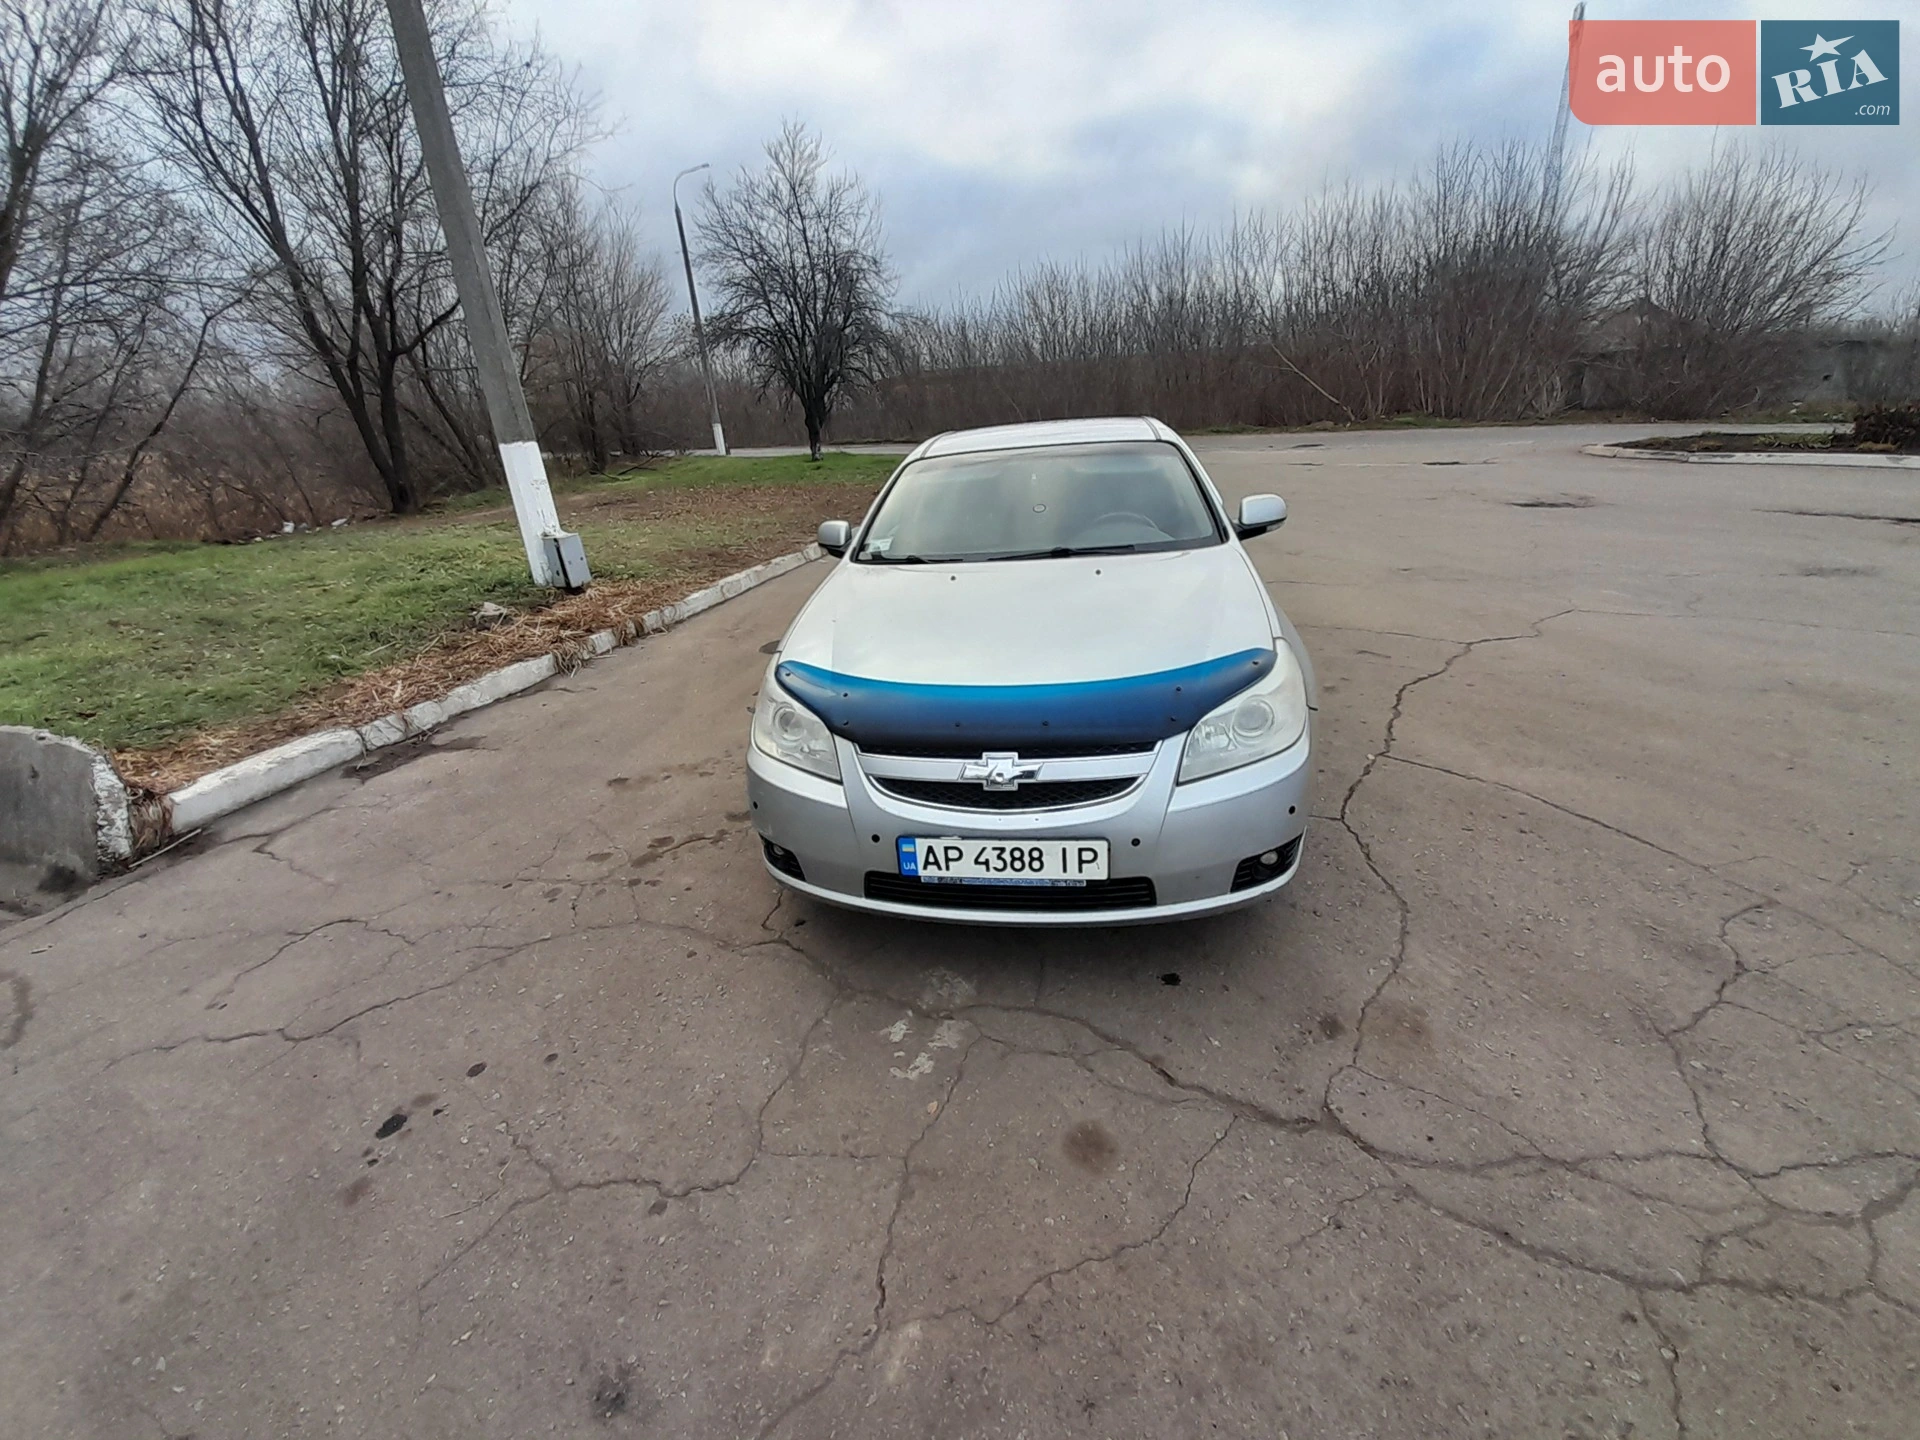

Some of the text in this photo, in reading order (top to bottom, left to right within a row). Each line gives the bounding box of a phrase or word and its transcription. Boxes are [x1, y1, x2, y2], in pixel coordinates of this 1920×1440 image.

[903, 862, 916, 870] UA
[922, 845, 1099, 873] AP 4388 IP
